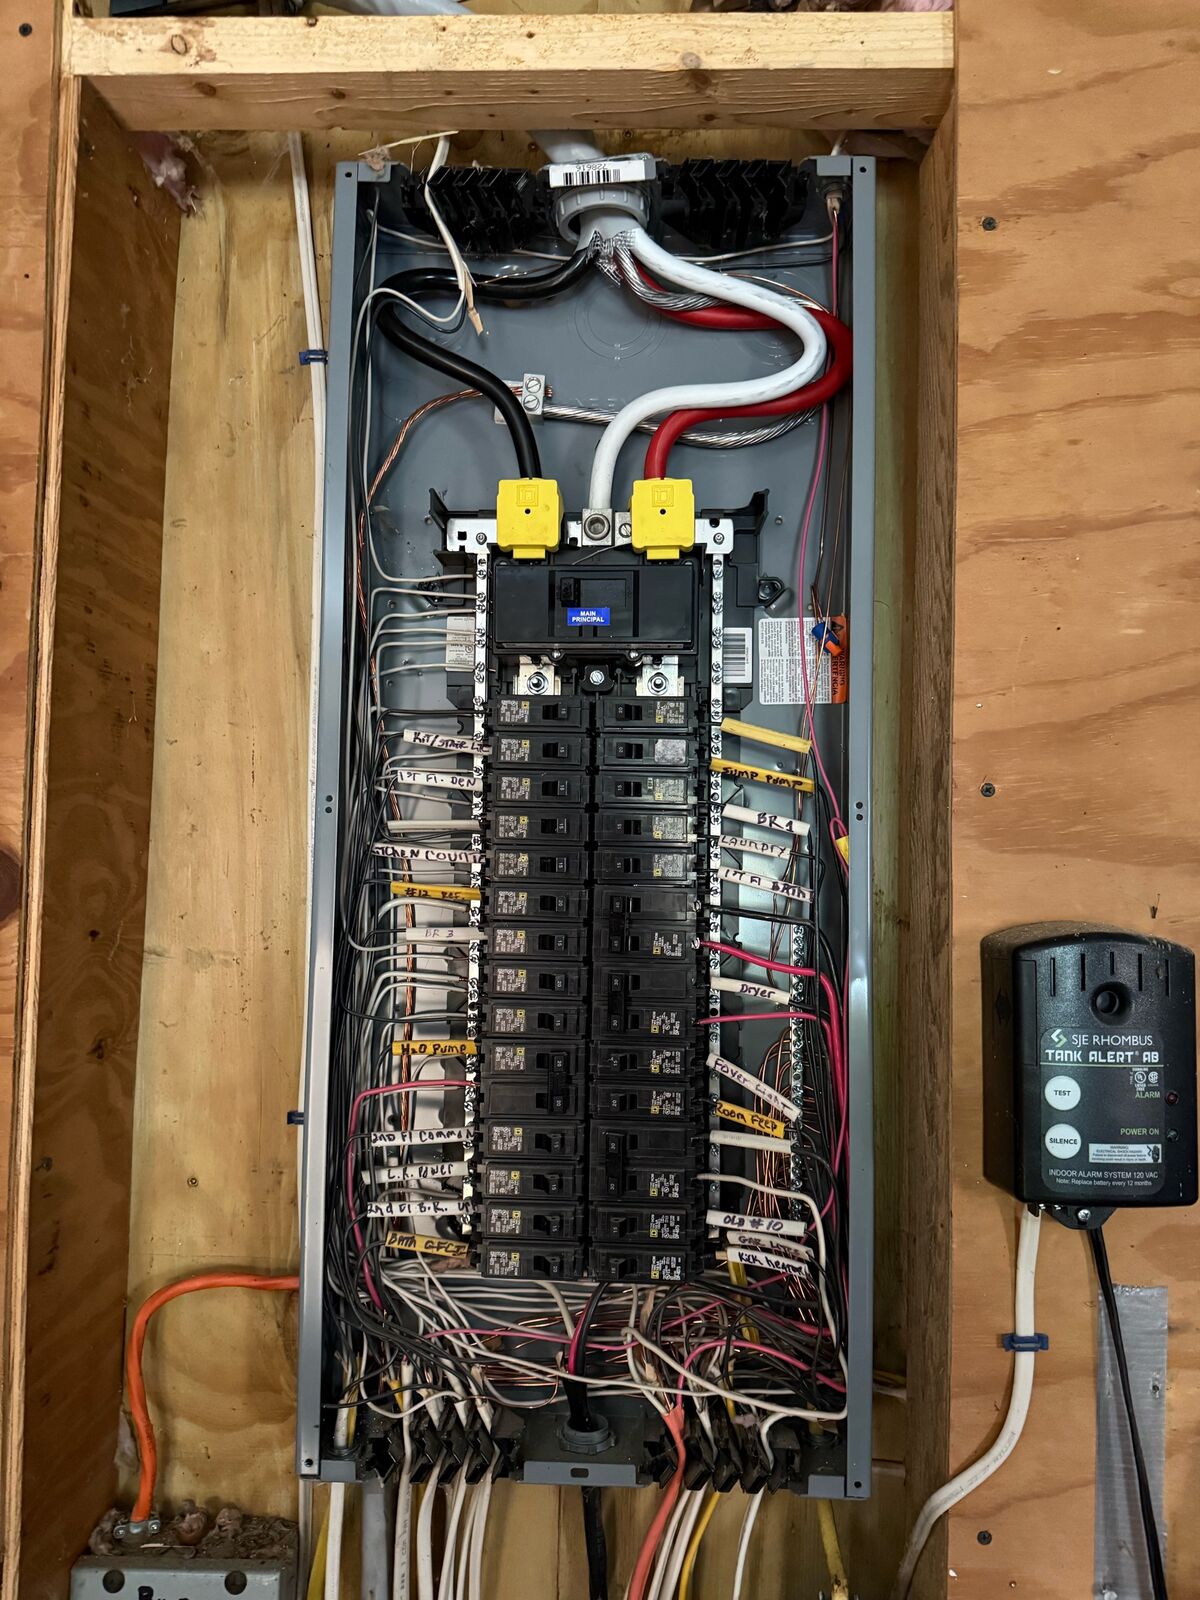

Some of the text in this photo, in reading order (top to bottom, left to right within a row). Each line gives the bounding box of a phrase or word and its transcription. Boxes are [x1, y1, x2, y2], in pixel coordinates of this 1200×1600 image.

[722, 766, 804, 789] SUMP PUMP
[1072, 1034, 1153, 1047] SJE RHOMBUS
[1045, 1050, 1082, 1062] TANK
[1142, 1051, 1159, 1063] AB
[1054, 1089, 1071, 1097] TEST
[1135, 1091, 1161, 1099] ALARM
[1120, 1128, 1160, 1136] POWER ON
[1049, 1137, 1078, 1145] SILENCE
[1049, 1168, 1077, 1177] INDOOR
[1078, 1169, 1102, 1178] ALARM
[1103, 1170, 1132, 1179] SYSTEM
[1133, 1171, 1145, 1179] 120
[1071, 1178, 1093, 1186] Replace
